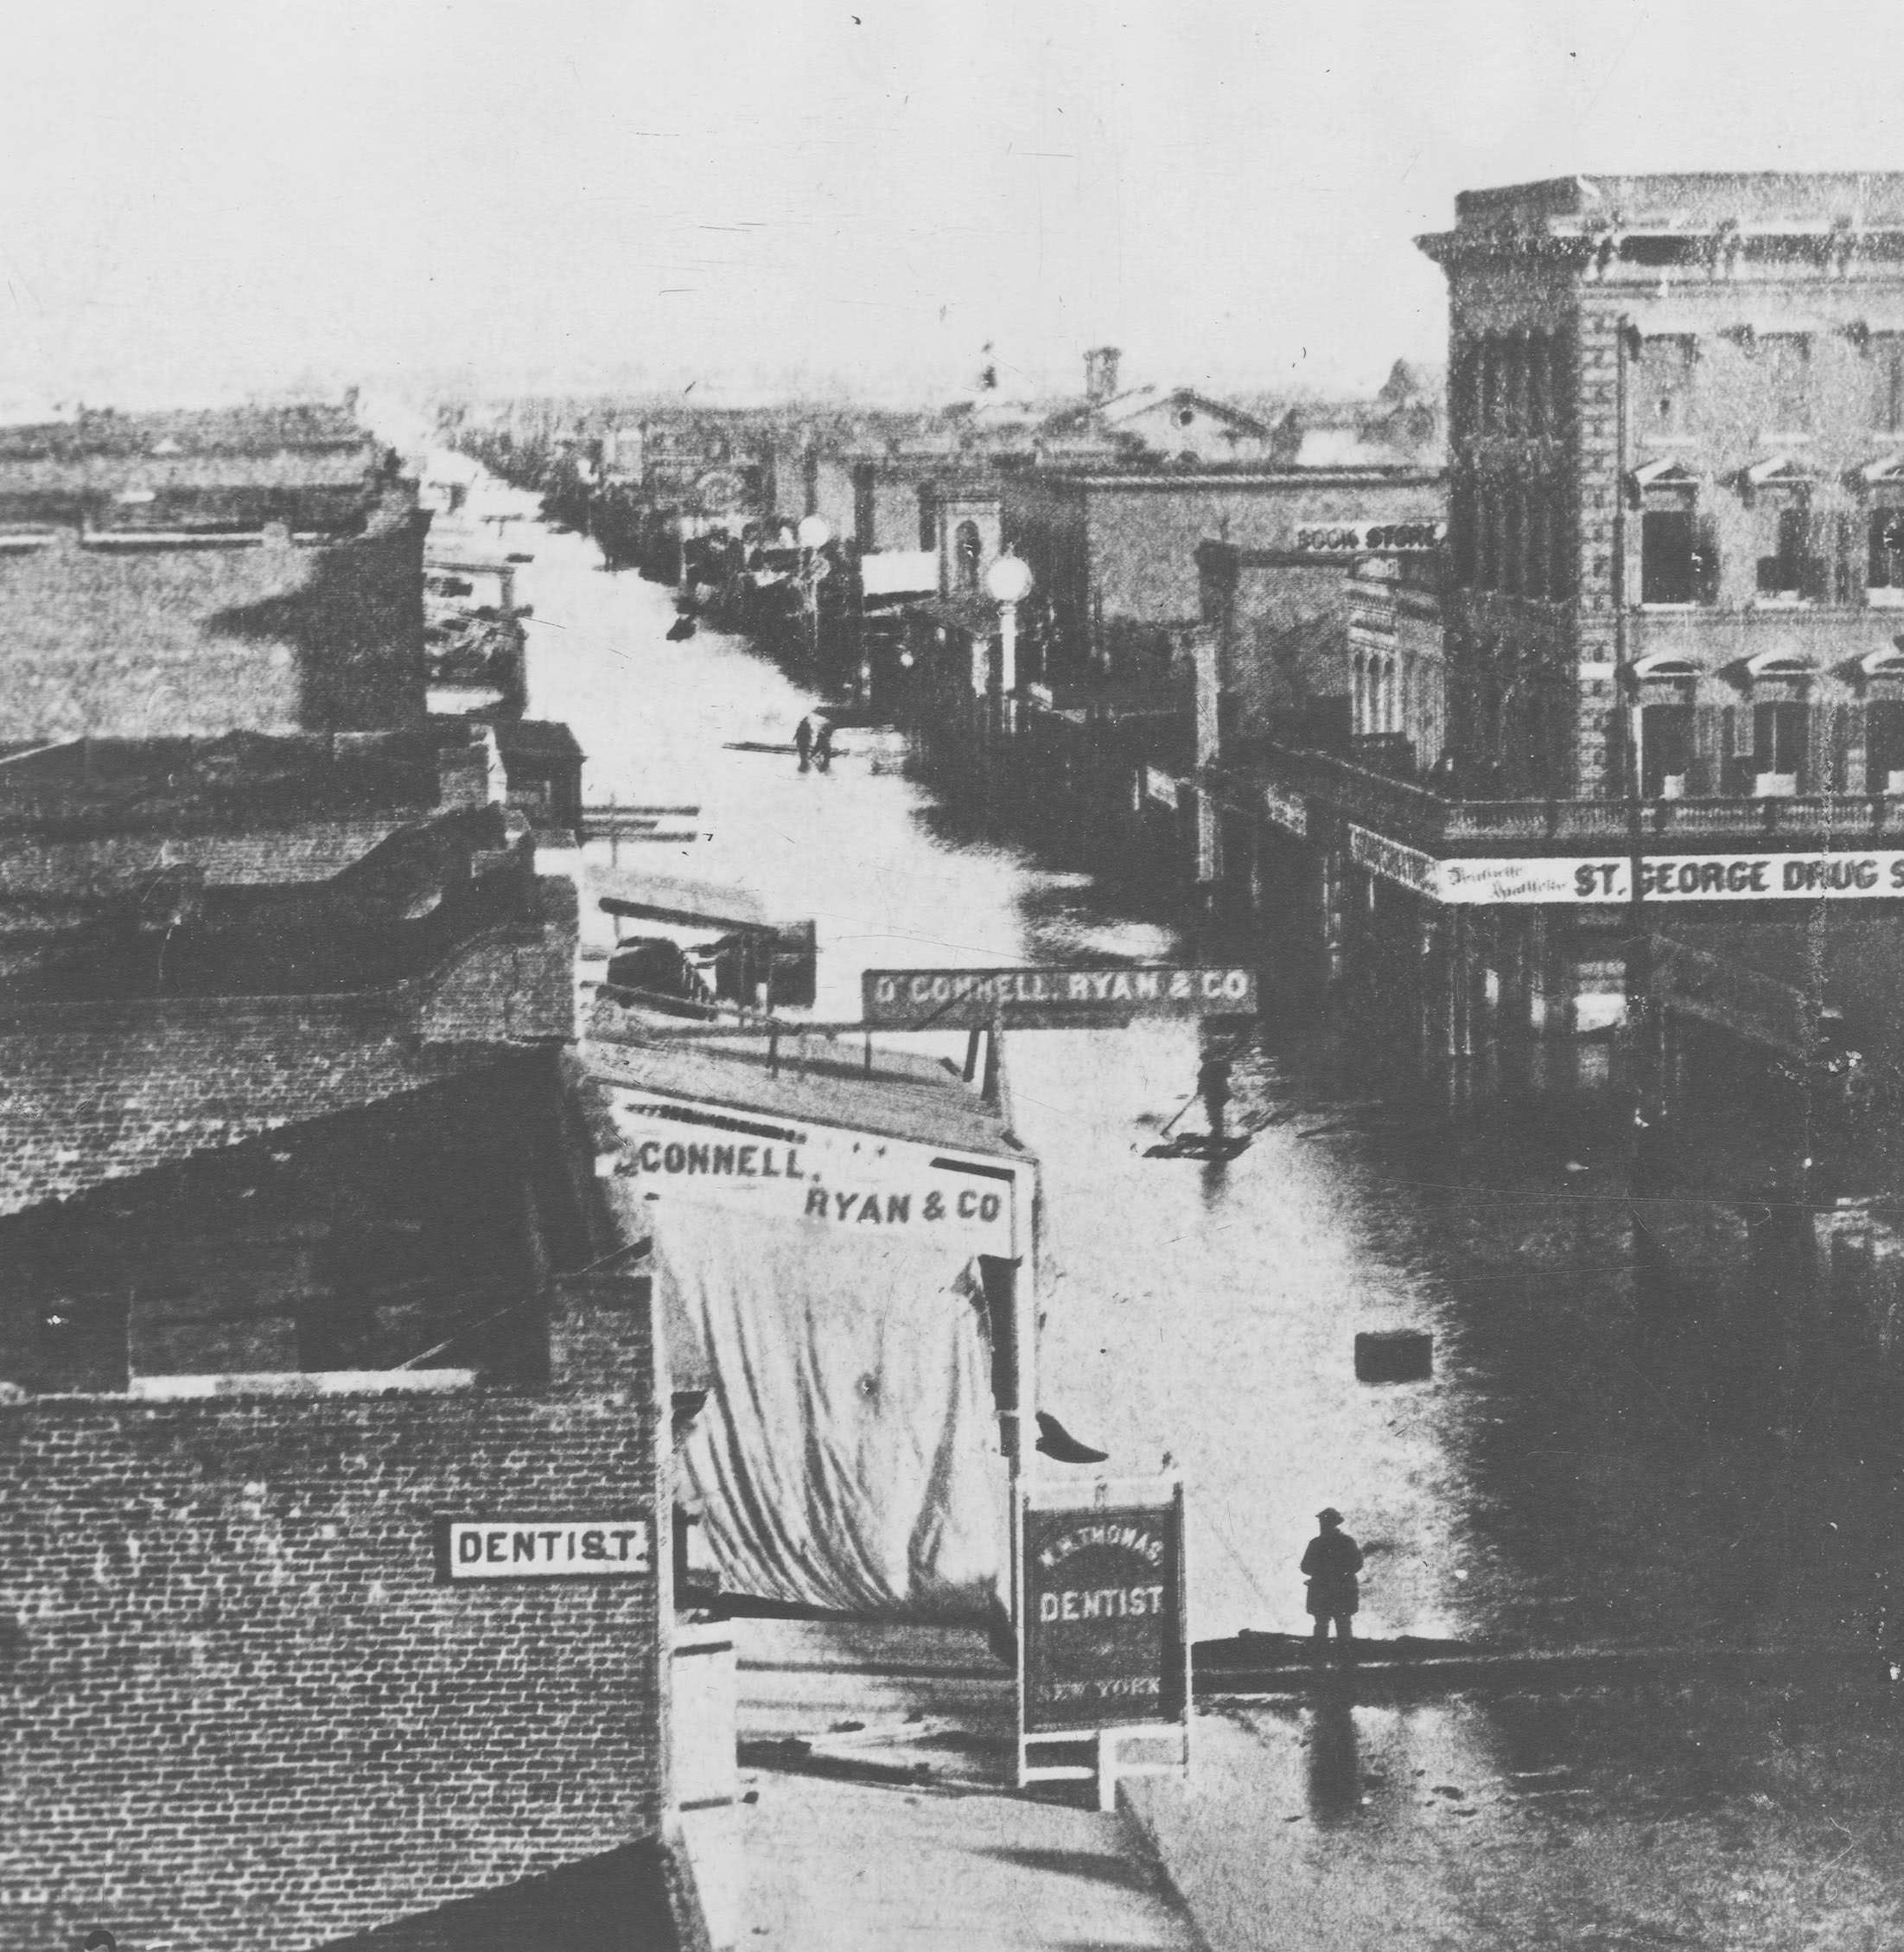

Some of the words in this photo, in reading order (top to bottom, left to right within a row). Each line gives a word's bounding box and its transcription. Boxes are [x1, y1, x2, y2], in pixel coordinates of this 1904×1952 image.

[1574, 864, 1627, 897] ST.
[1783, 859, 1879, 891] DRUG
[1068, 972, 1159, 1000] RYAN
[1168, 971, 1192, 998] &
[1202, 968, 1250, 999] CO
[805, 1188, 912, 1224] RYAN
[921, 1190, 946, 1221] &
[957, 1190, 1002, 1222] CO
[1040, 1585, 1163, 1623] DENTIST
